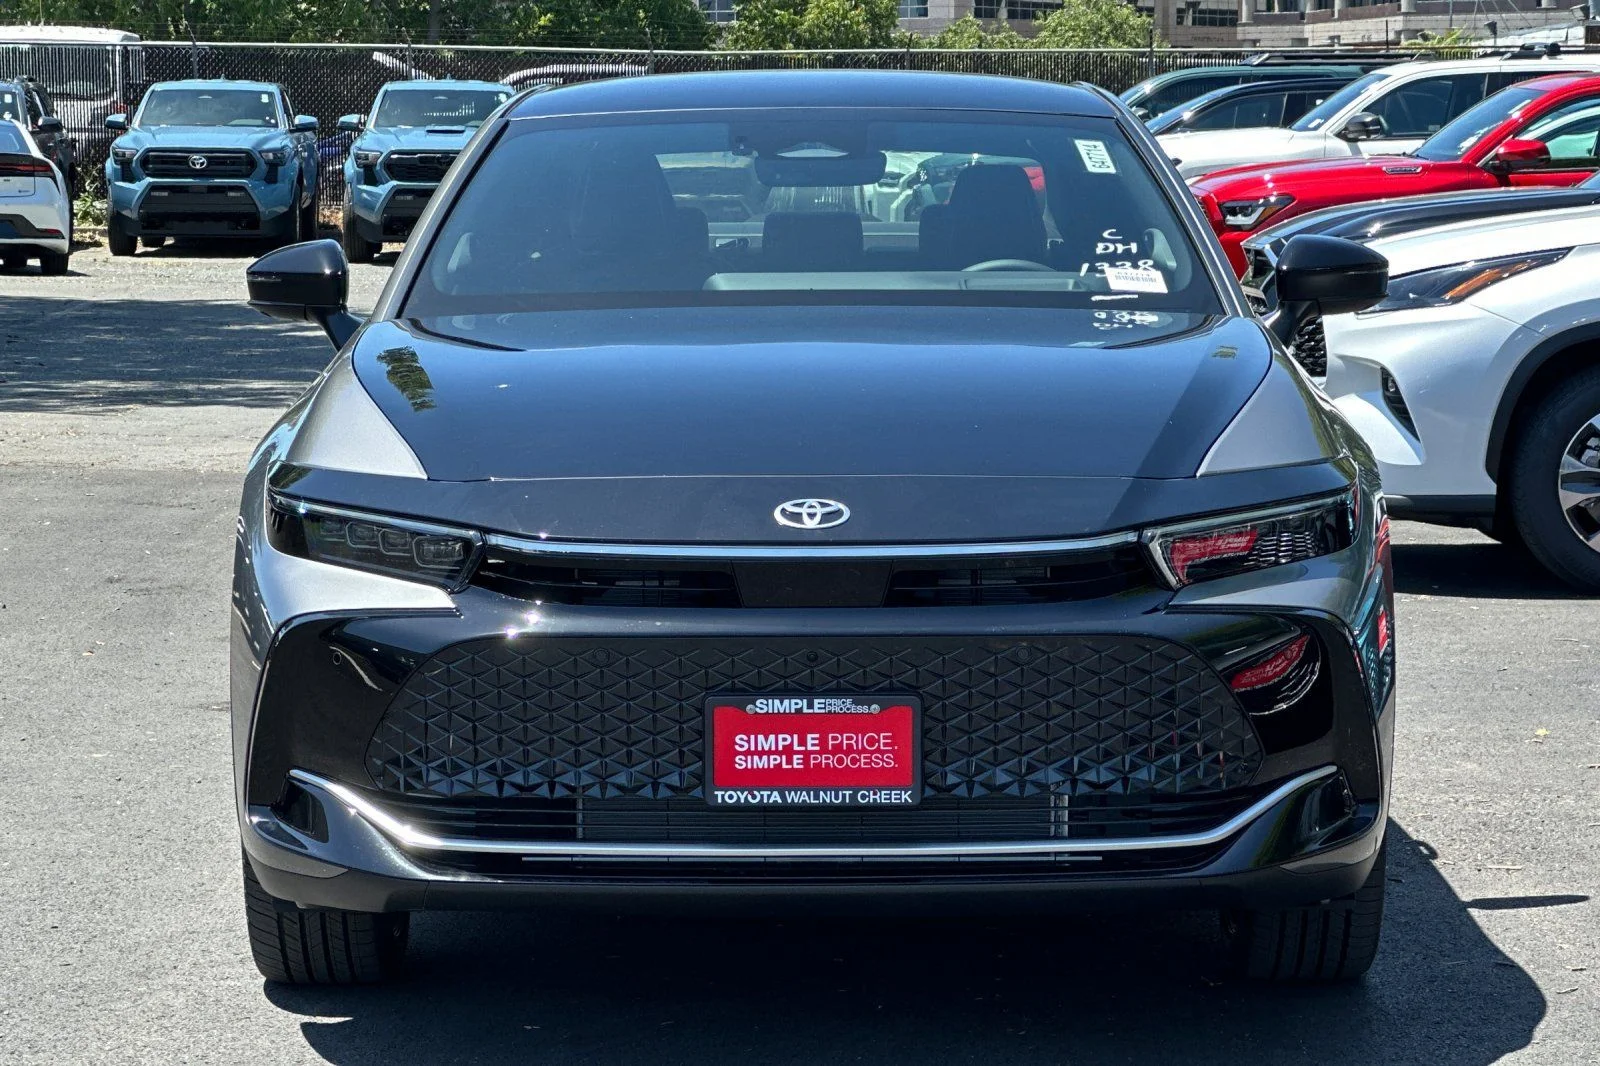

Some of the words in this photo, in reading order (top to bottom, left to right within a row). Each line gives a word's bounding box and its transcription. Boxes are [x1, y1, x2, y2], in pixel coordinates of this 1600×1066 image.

[755, 698, 826, 714] SIMPLE
[734, 733, 820, 751] SIMPLE
[827, 732, 899, 751] PRICE.
[734, 754, 804, 770] SIMPLE
[809, 753, 899, 769] PROCESS.
[714, 790, 782, 804] TOYOTA
[785, 790, 853, 804] WALNUT
[857, 790, 913, 804] CREEK
